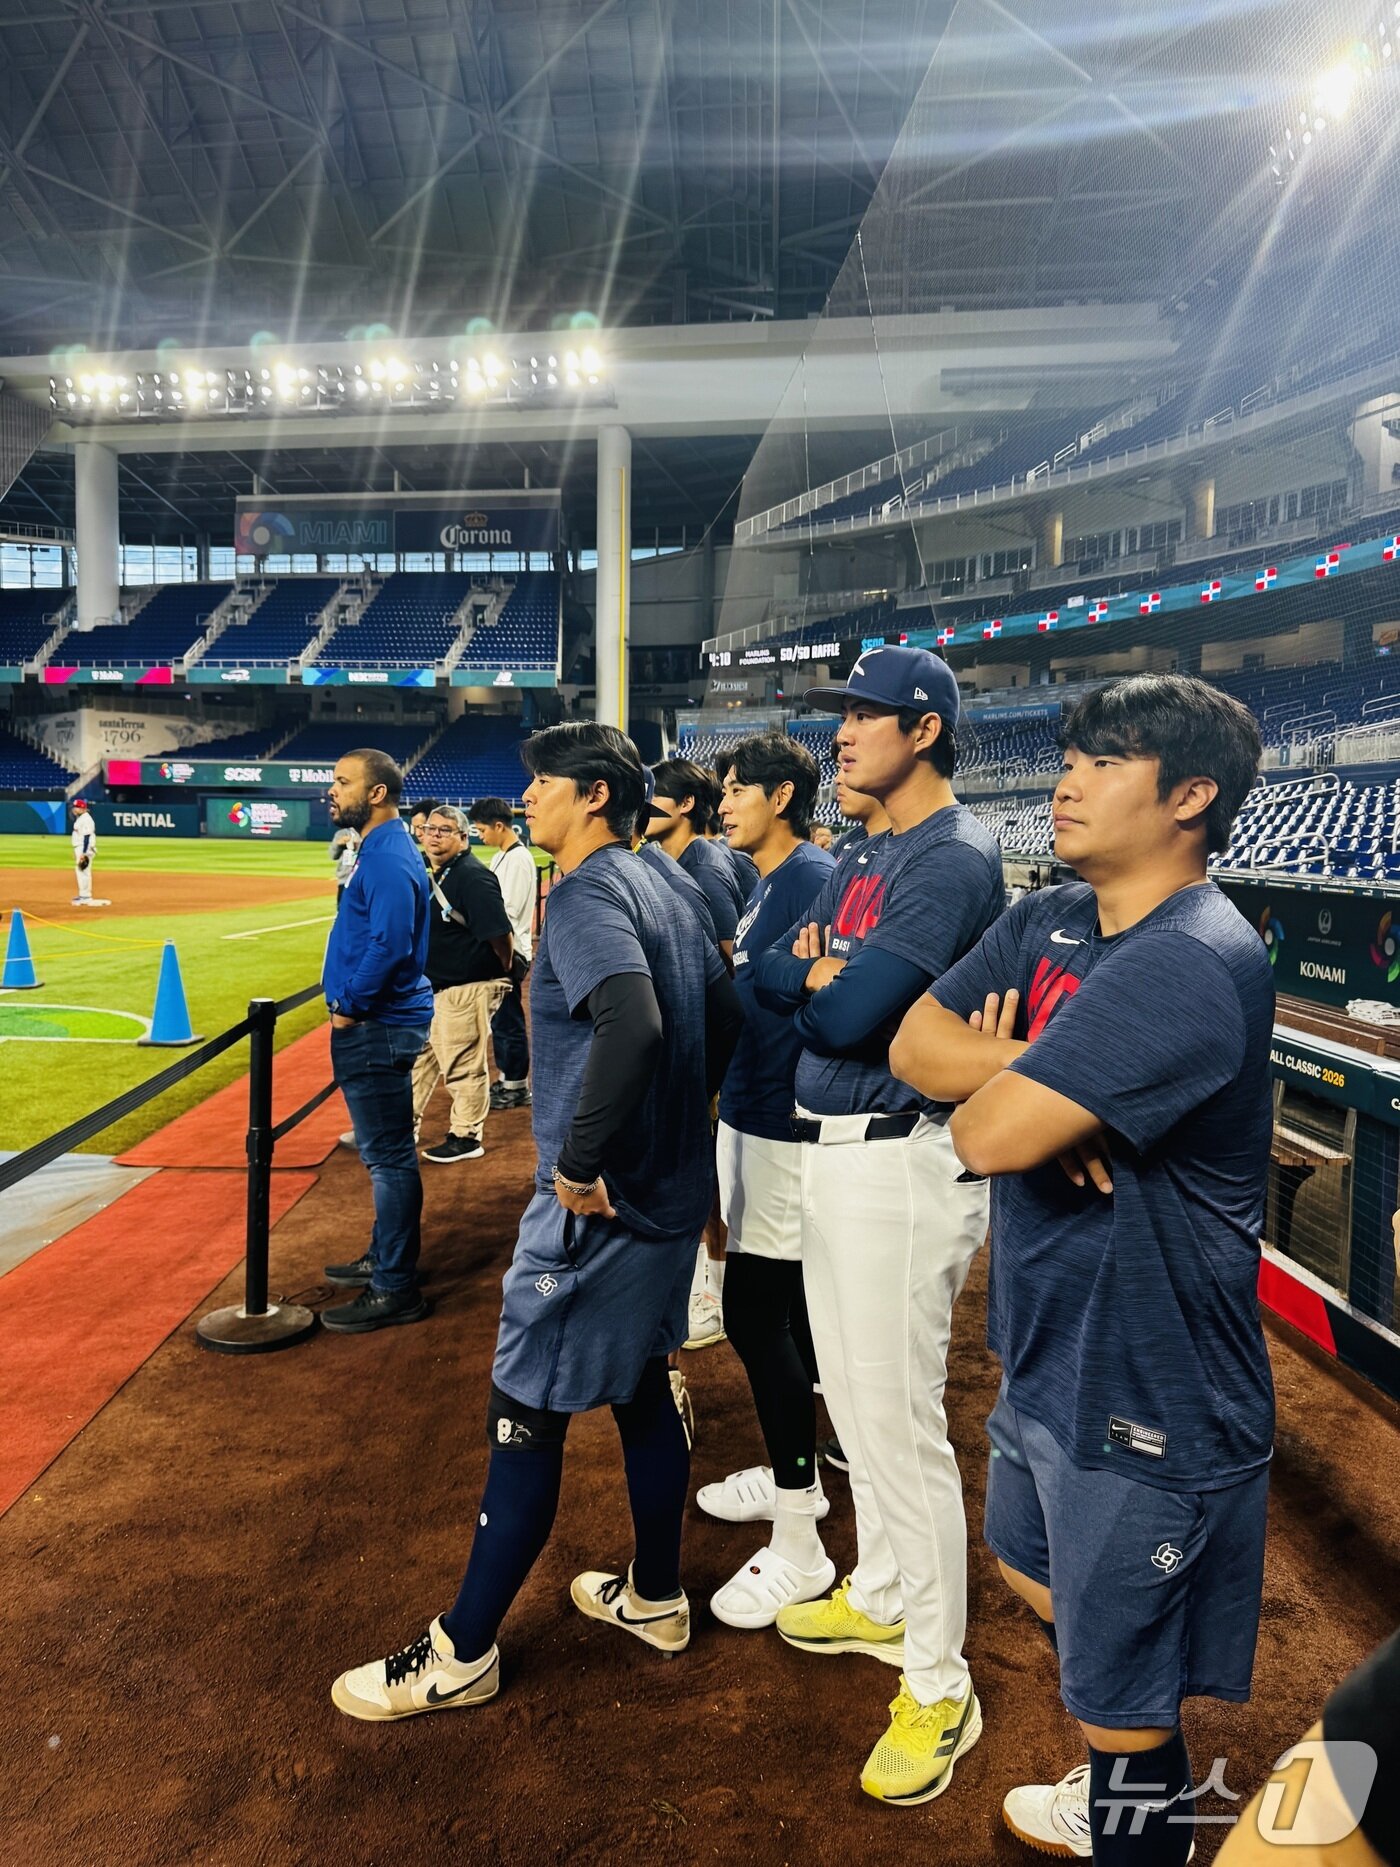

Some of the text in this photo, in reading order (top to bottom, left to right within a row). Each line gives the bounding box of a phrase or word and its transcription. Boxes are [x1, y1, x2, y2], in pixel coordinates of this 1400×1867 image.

[301, 520, 388, 546] MIAMI
[440, 524, 512, 550] Corona
[708, 651, 732, 668] 4:10
[739, 656, 776, 666] FOUNDATION
[780, 642, 840, 663] 50/50 RAFFLE
[103, 730, 142, 746] 1796
[301, 769, 336, 783] Mobil
[112, 812, 176, 828] TENTIAL
[1300, 960, 1346, 985] KONAMI
[1285, 1054, 1322, 1079] CLASSIC
[1321, 1067, 1345, 1088] 2026
